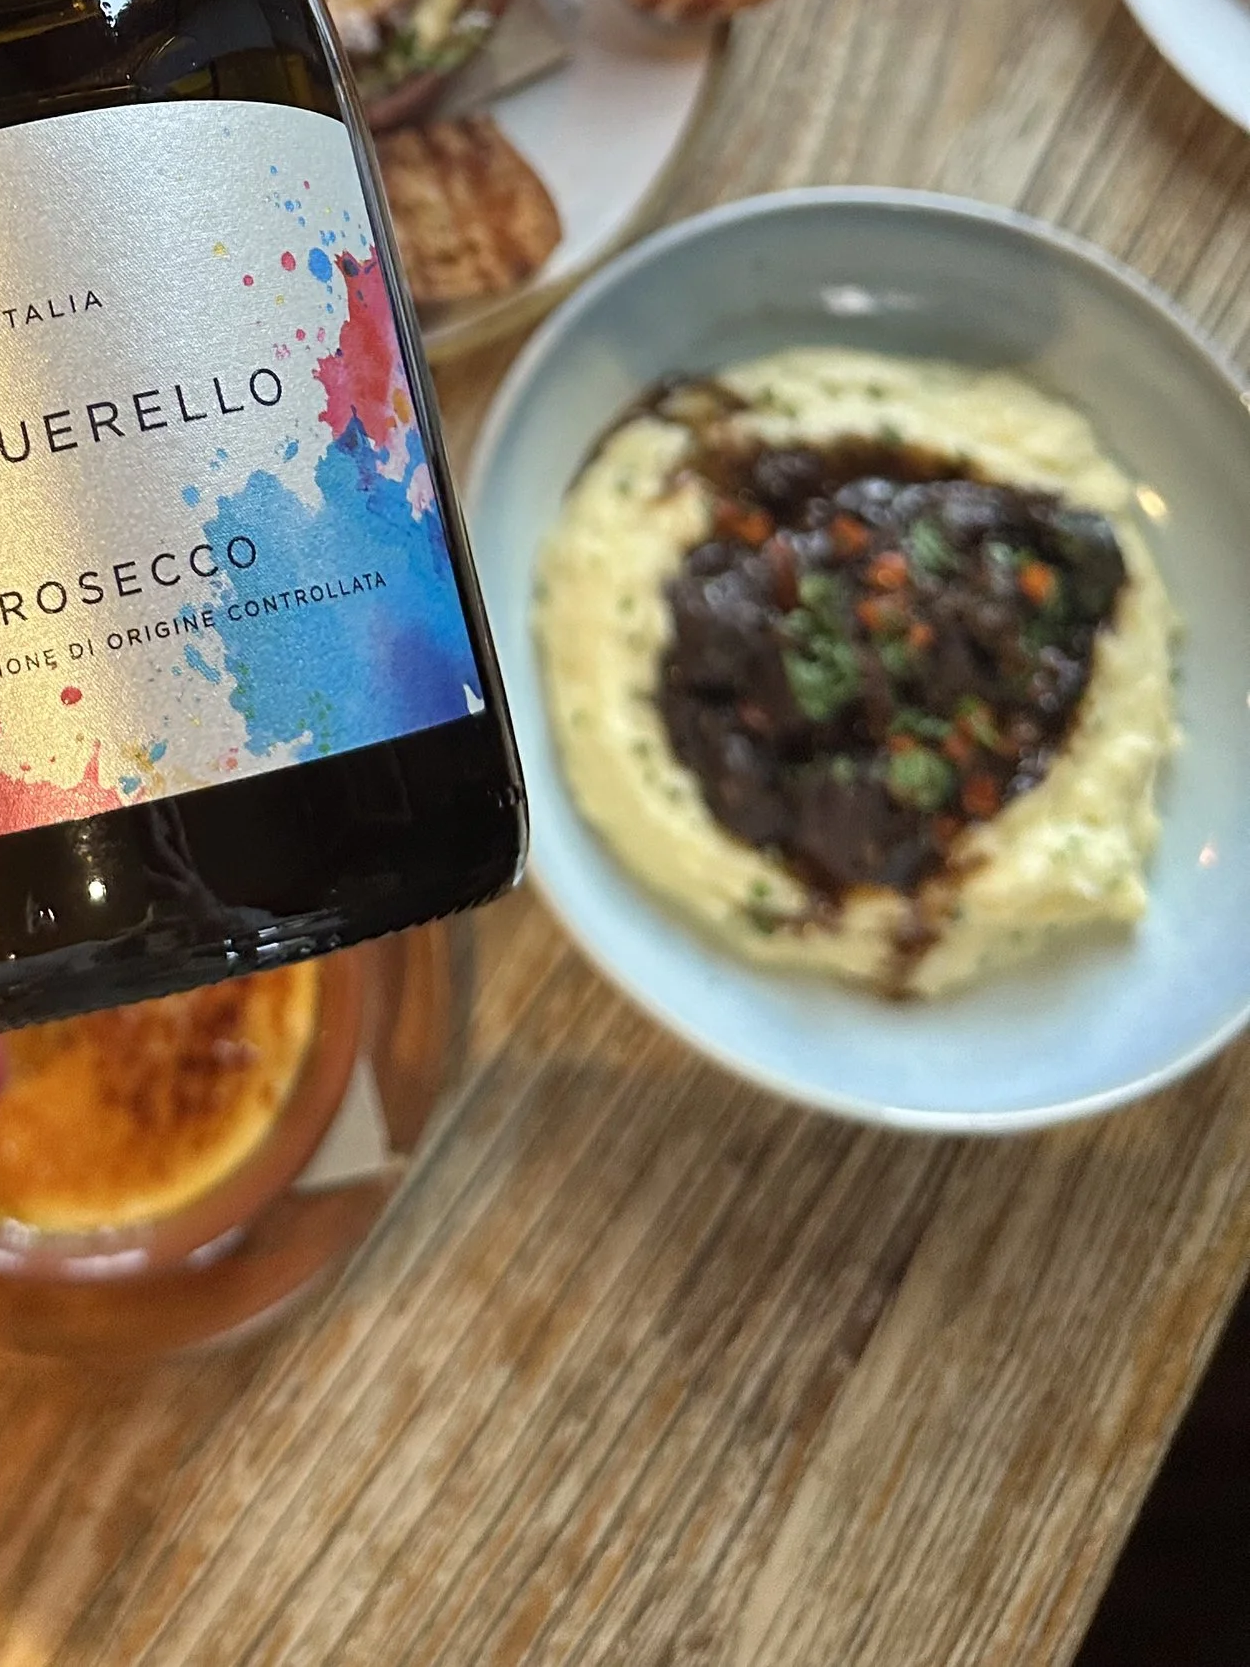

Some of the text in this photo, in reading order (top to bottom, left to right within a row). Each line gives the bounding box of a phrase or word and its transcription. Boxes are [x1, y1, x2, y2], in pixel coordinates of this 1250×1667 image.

[68, 638, 95, 661] DI
[106, 610, 217, 651] ORIGINE
[226, 571, 388, 622] CONTROLLATA
